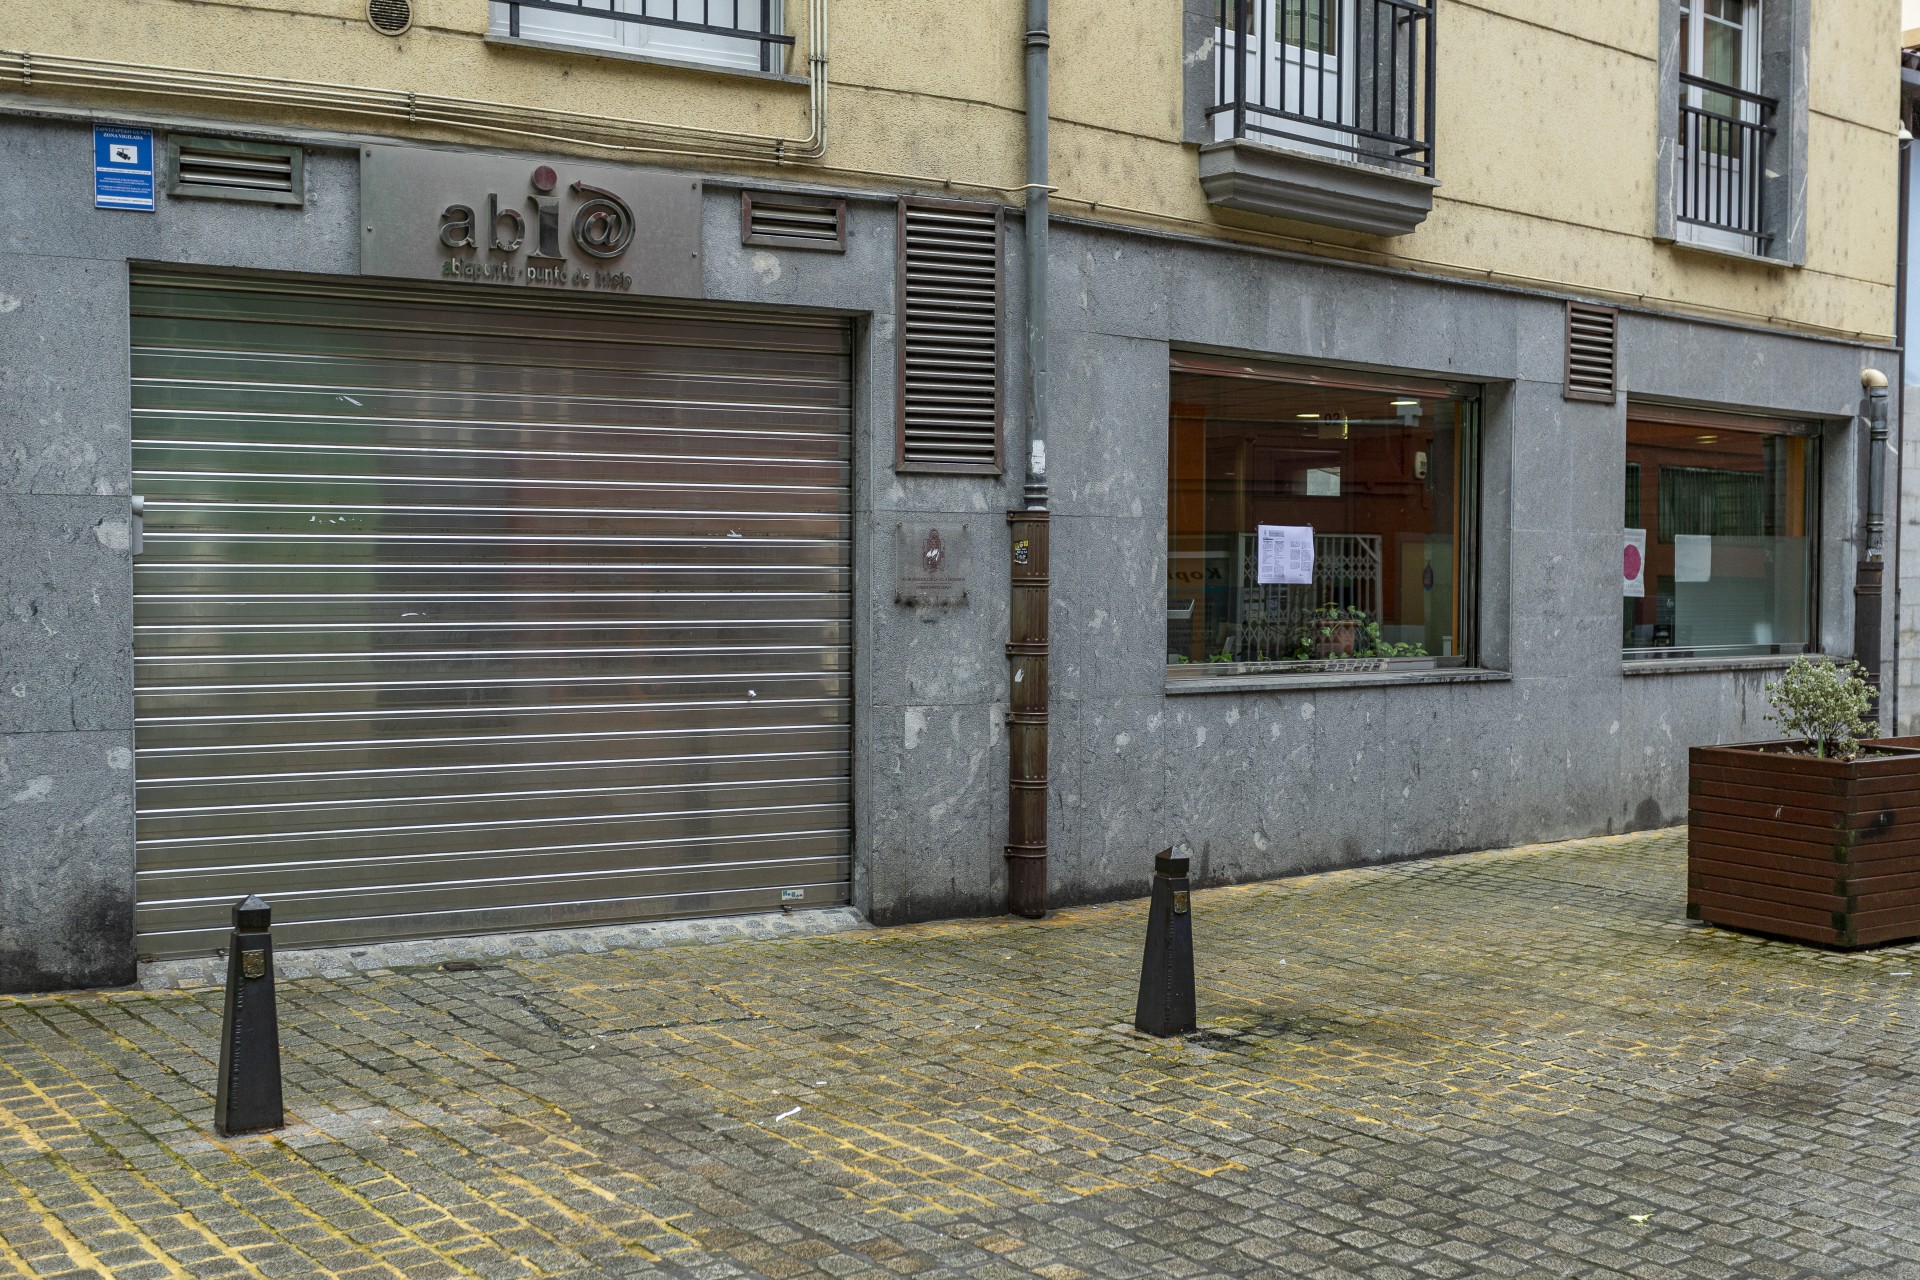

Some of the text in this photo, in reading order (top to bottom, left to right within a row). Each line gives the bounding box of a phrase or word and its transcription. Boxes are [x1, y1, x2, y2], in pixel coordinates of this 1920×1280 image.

[118, 133, 144, 141] VIGILADA
[527, 266, 568, 285] punto
[572, 268, 591, 286] de
